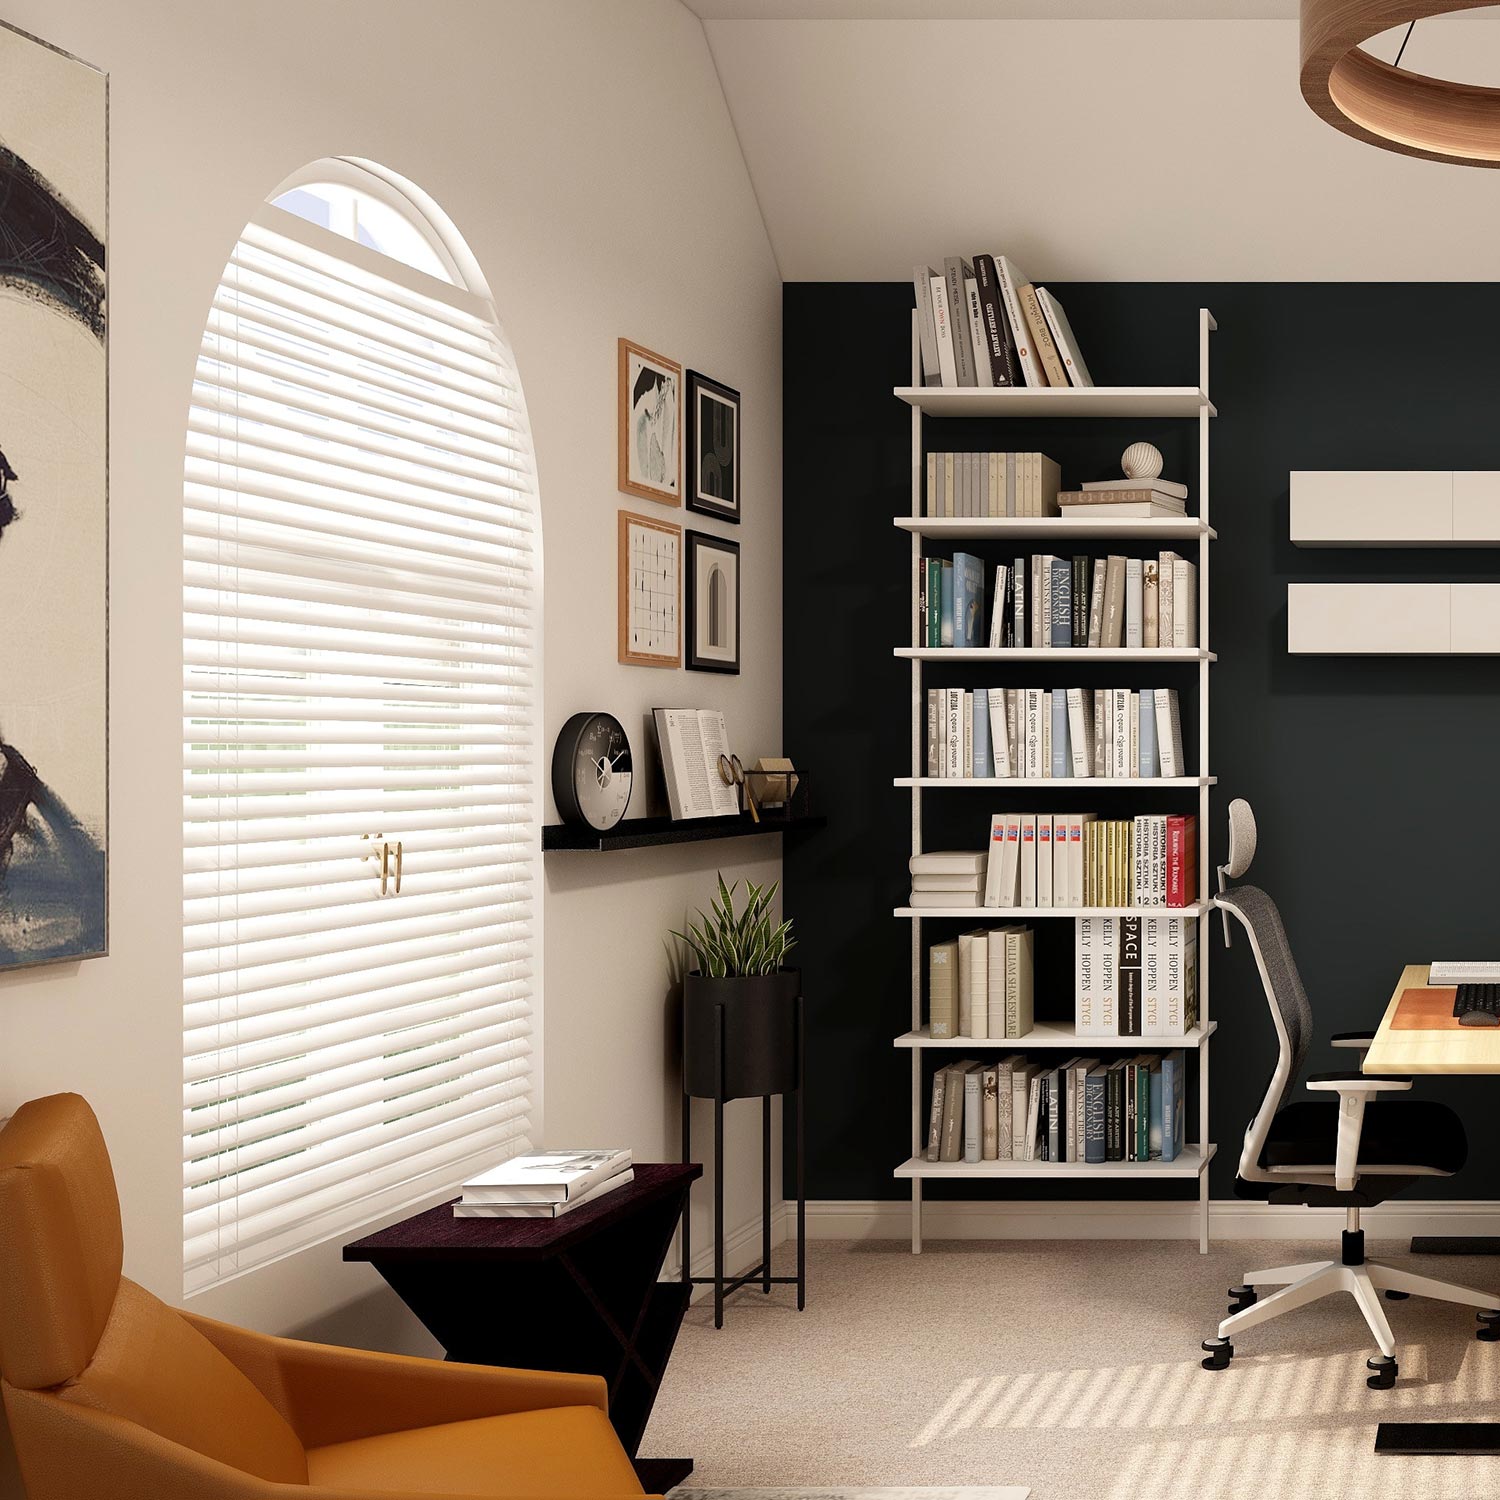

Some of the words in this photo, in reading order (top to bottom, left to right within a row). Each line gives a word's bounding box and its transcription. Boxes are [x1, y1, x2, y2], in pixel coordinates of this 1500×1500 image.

[937, 309, 945, 325] OWN
[1014, 575, 1024, 616] LATIN
[1058, 568, 1070, 625] ENGLISH
[1137, 896, 1142, 904] 1
[1143, 897, 1150, 905] 2
[1152, 897, 1159, 905] 3
[1160, 895, 1166, 903] 4
[1081, 919, 1091, 948] KELLY
[1103, 919, 1112, 948] KELLY
[1125, 916, 1137, 960] SPACE
[1147, 919, 1157, 948] KELLY
[1168, 919, 1178, 948] KELLY
[1008, 936, 1017, 975] WILLIAM
[1081, 953, 1091, 991] HOPPEN
[1103, 953, 1112, 991] HOPPEN
[1147, 953, 1157, 991] HOPPEN
[1168, 953, 1178, 991] HOPPEN
[1008, 977, 1017, 1036] SHAKESPEARE
[1049, 1089, 1058, 1130] LATIN
[1093, 1084, 1104, 1140] ENGLISH
